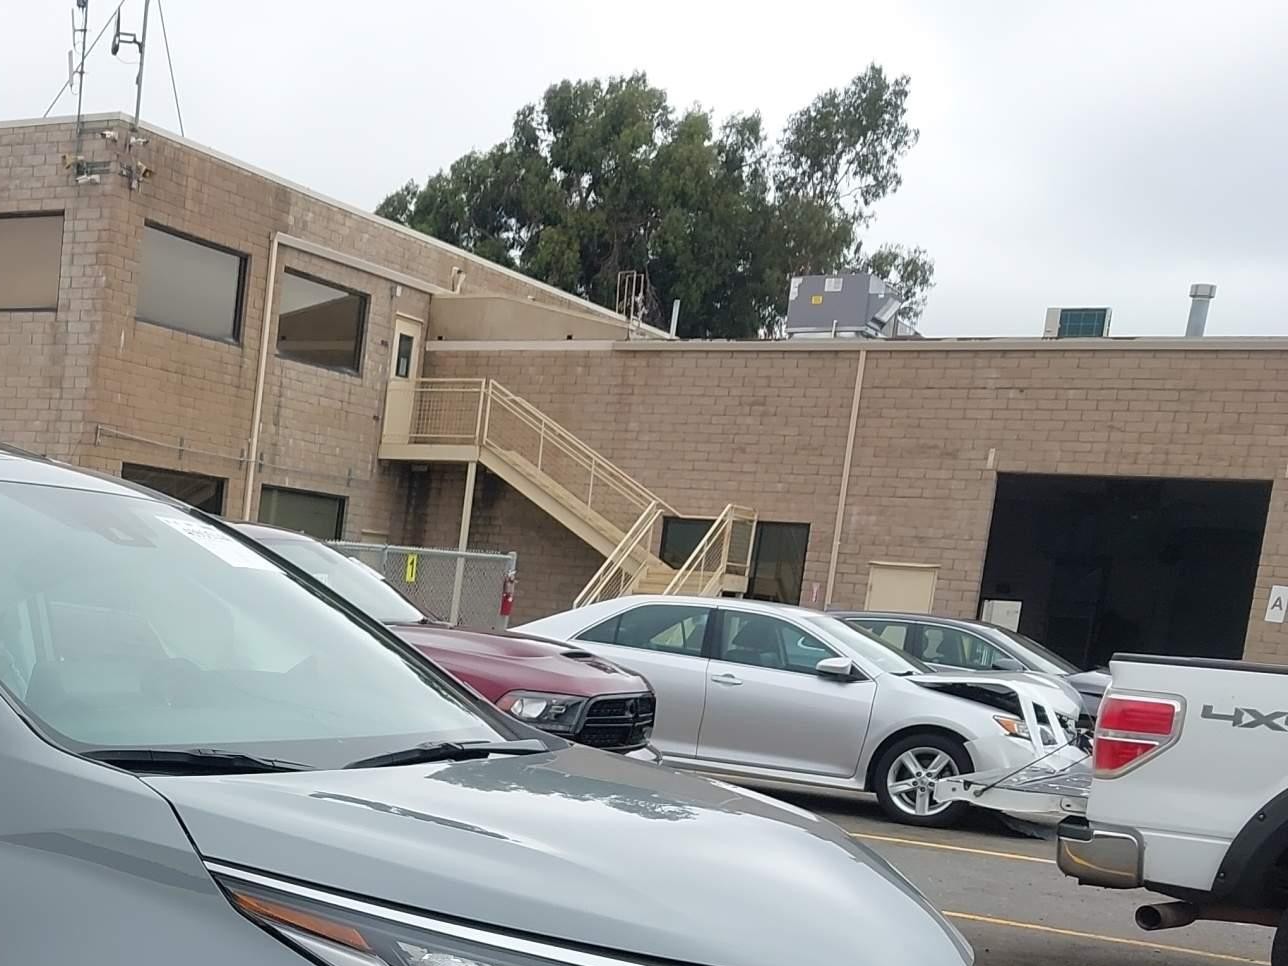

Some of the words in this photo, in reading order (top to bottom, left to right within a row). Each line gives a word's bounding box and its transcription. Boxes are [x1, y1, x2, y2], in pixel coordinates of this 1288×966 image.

[409, 557, 415, 578] 1
[1270, 596, 1283, 611] A
[1200, 704, 1288, 732] 4X
